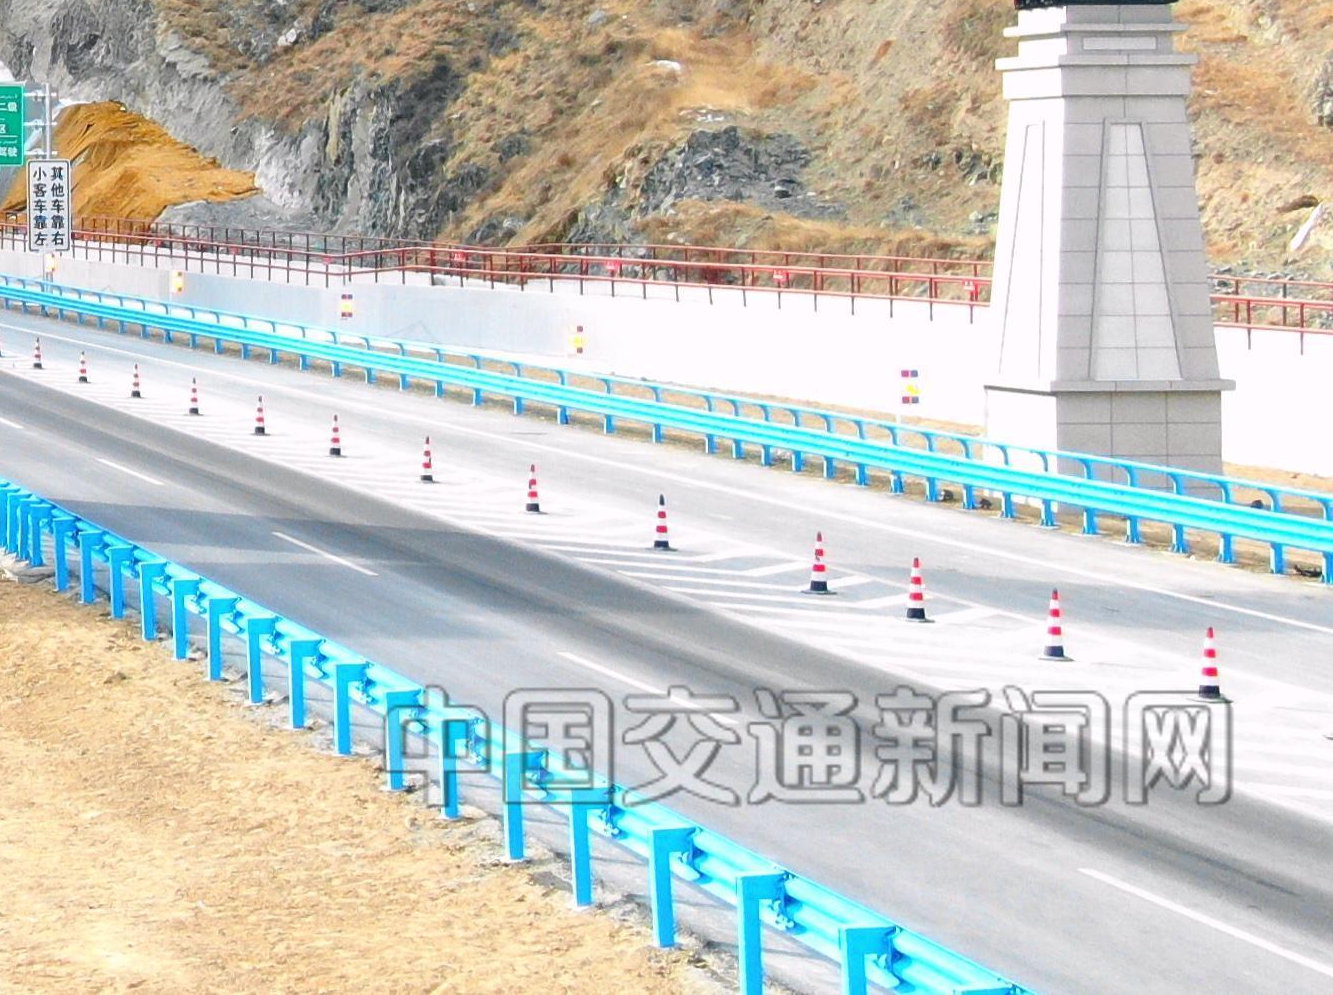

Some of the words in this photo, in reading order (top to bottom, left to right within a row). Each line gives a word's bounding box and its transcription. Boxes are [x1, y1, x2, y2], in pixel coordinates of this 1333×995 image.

[33, 166, 48, 246] 小客车靠左
[50, 166, 65, 246] 其他车靠右
